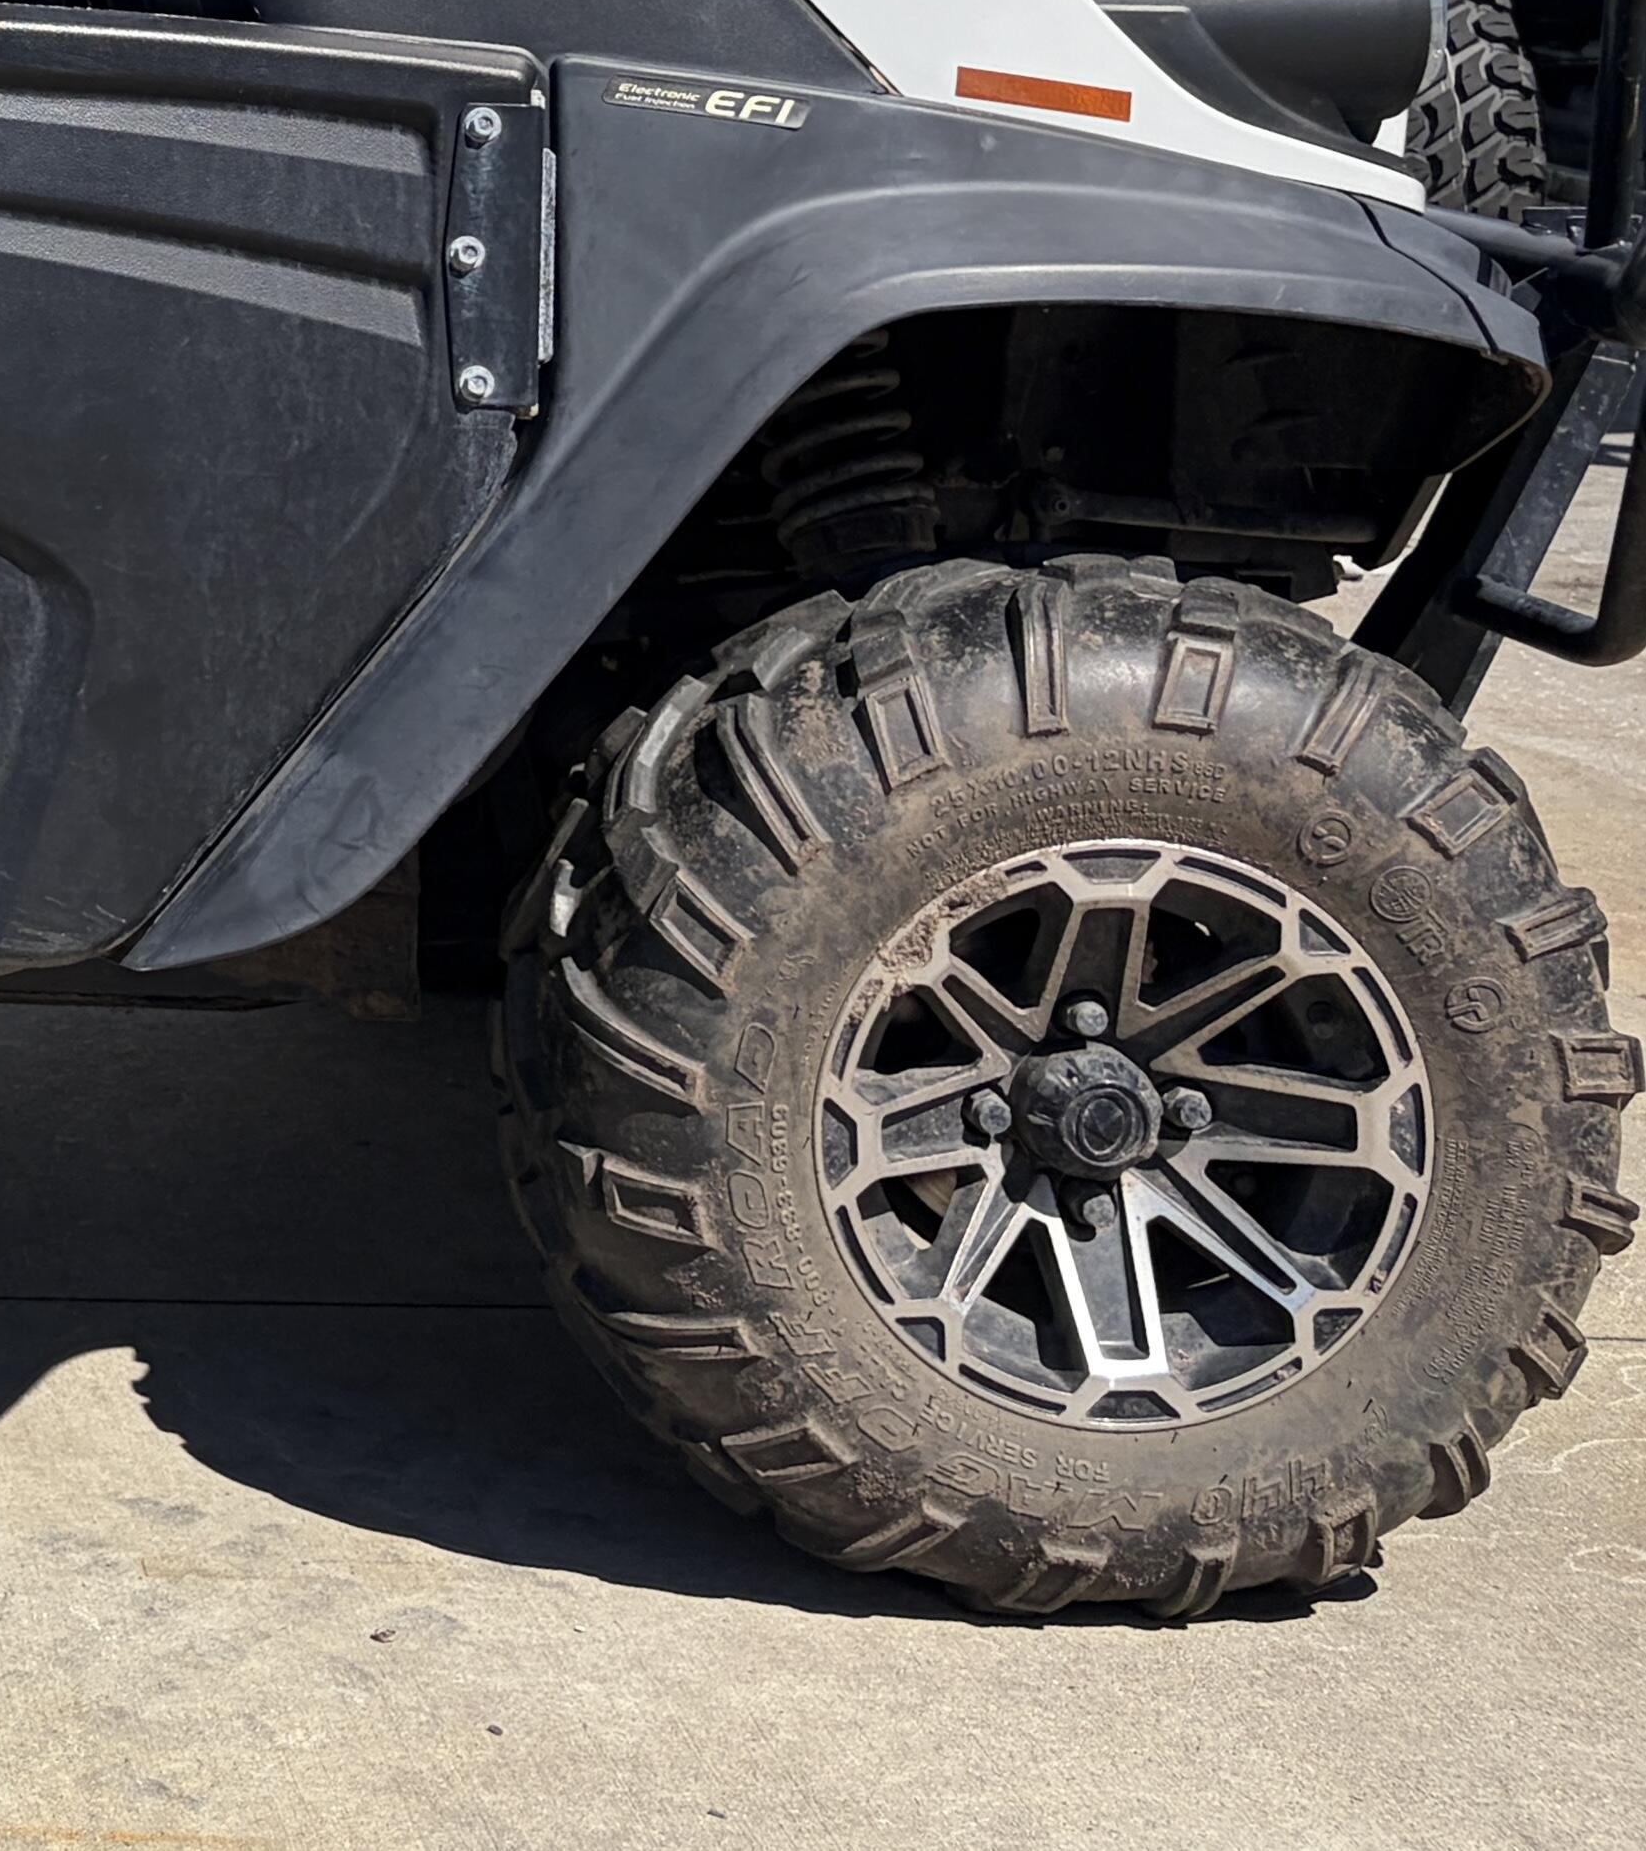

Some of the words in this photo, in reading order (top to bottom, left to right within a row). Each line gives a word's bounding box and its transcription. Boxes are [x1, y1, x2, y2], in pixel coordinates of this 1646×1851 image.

[614, 92, 643, 104] Fuel
[645, 95, 697, 110] Injection
[618, 82, 701, 102] Electronic
[705, 89, 795, 125] EFI
[906, 827, 947, 859] NOT
[958, 802, 999, 830] FOR
[1010, 777, 1112, 810] HIGHWAY
[1129, 776, 1228, 804] SERVICE
[725, 1021, 797, 1291] ROAD
[768, 1311, 922, 1454] OFF
[919, 1402, 1039, 1471] SERVICE
[1055, 1453, 1109, 1484] FOR
[923, 1451, 1165, 1532] MAG
[1190, 1457, 1330, 1526] 440
